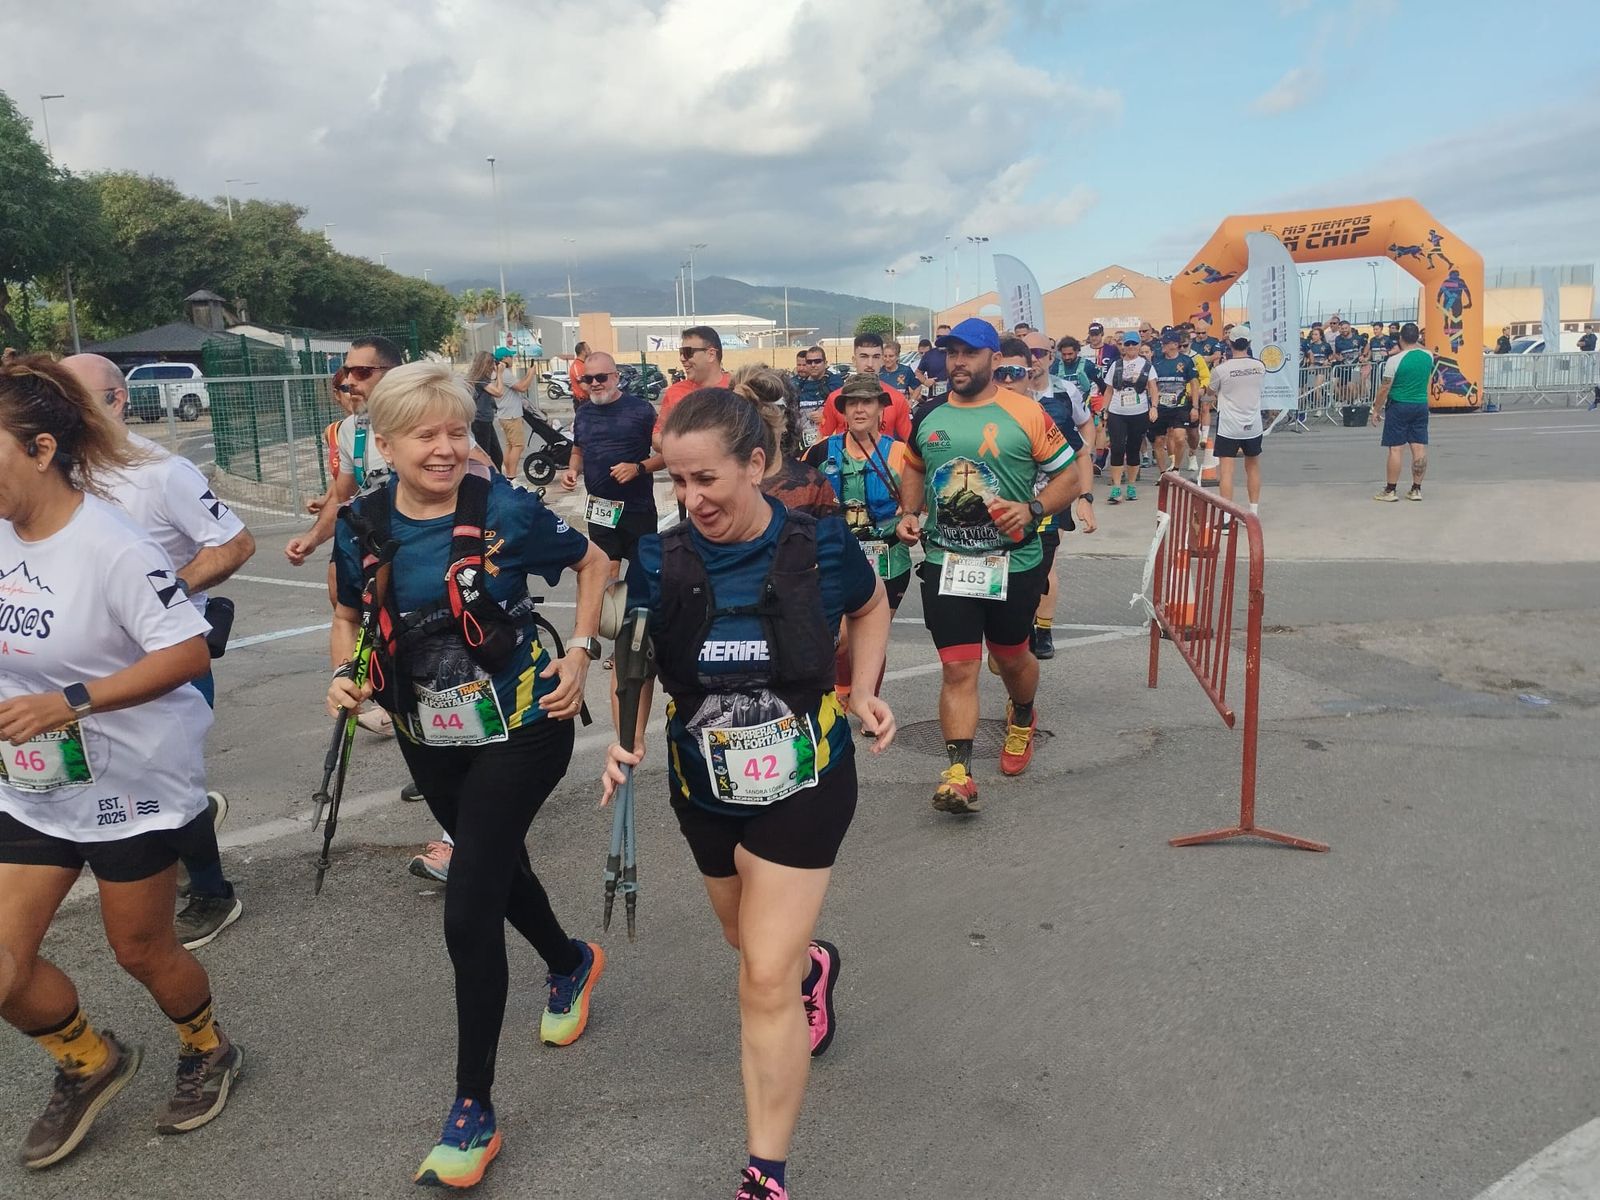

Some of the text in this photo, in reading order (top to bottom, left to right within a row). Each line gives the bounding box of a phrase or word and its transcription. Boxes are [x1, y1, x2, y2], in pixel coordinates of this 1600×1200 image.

[1281, 215, 1372, 236] MIS TIEMPOS
[1305, 226, 1370, 250] CHIP
[595, 507, 612, 518] 154
[958, 570, 986, 585] 163
[0, 598, 54, 639] OS@S
[432, 713, 464, 730] 44
[730, 739, 743, 750] LA
[744, 728, 800, 749] FORTALEZA
[15, 749, 46, 772] 46
[744, 754, 780, 781] 42
[98, 796, 124, 811] EST.
[97, 810, 127, 826] 2025
